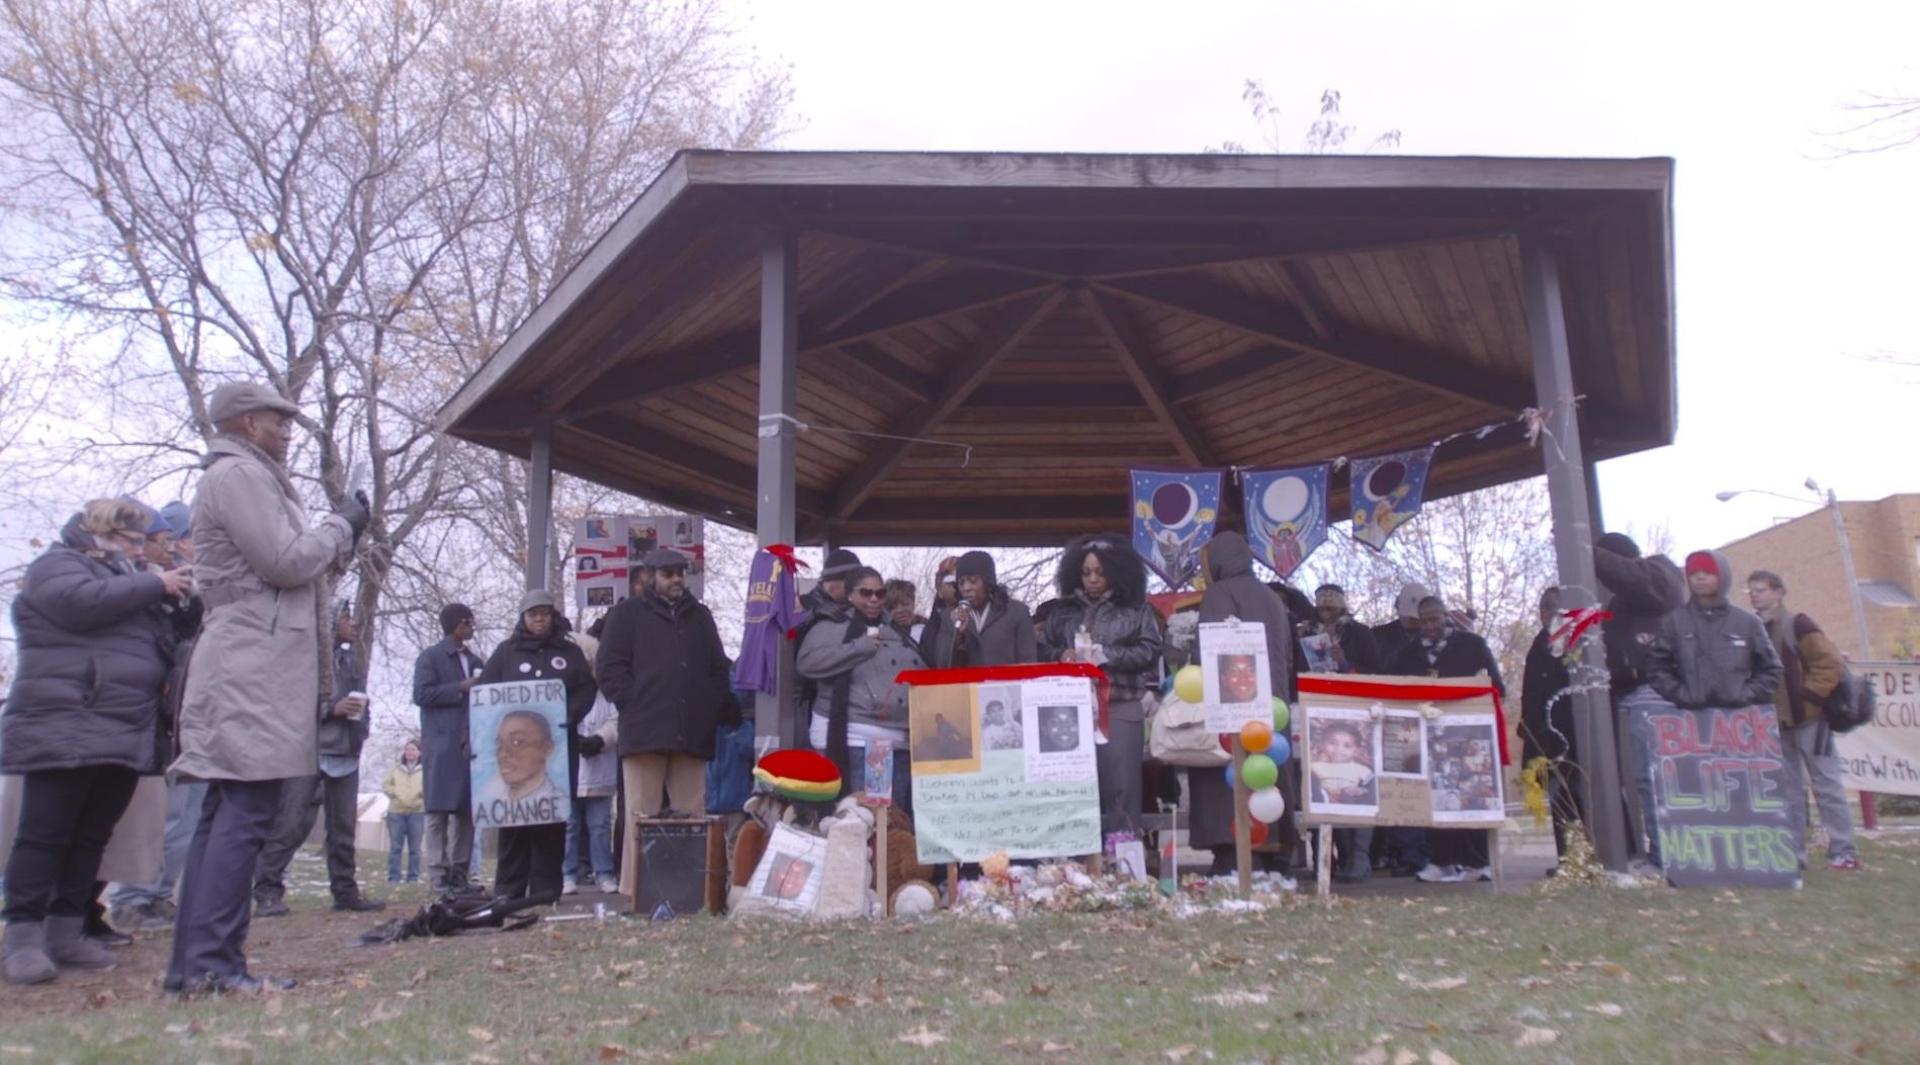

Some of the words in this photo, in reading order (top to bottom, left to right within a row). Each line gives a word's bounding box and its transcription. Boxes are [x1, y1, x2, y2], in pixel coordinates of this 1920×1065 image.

[471, 690, 484, 707] I
[490, 685, 532, 705] DIED
[535, 681, 565, 702] FOR
[1648, 704, 1783, 758] BLACK
[1662, 757, 1784, 813] LIFE
[475, 805, 490, 825] A
[491, 797, 561, 825] CHANGE
[1658, 825, 1798, 872] MATTERS
